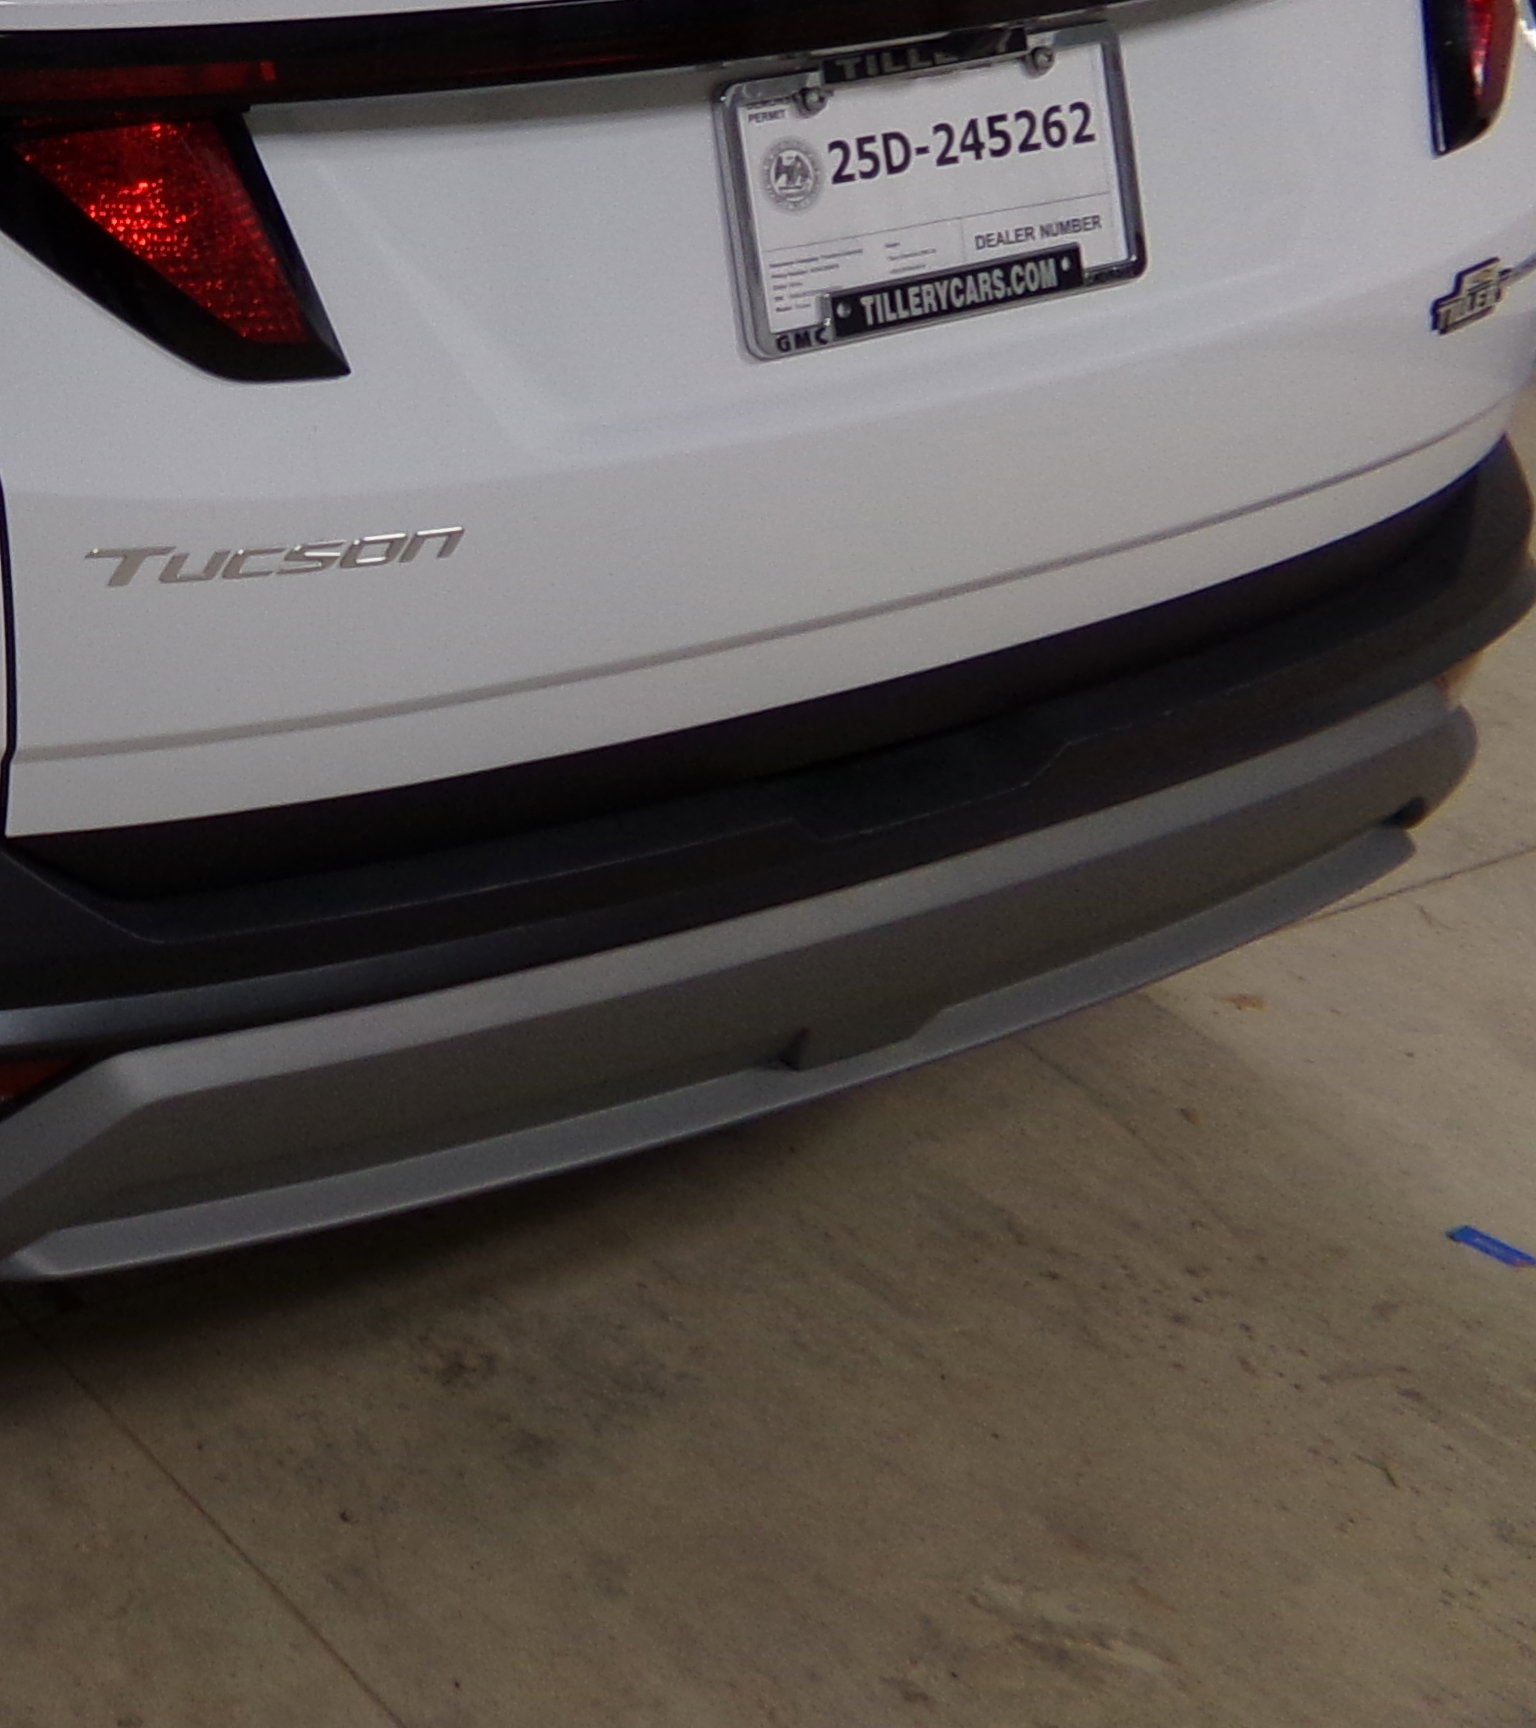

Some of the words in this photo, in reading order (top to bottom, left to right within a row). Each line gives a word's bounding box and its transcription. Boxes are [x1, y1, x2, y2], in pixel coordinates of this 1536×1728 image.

[827, 101, 1097, 185] 25D-245262
[974, 225, 1034, 251] DEALER
[1039, 214, 1103, 239] NUMBER
[859, 257, 1060, 328] TILLERYCARS.COM
[775, 325, 830, 354] GMC
[84, 525, 466, 587] TUCSON
